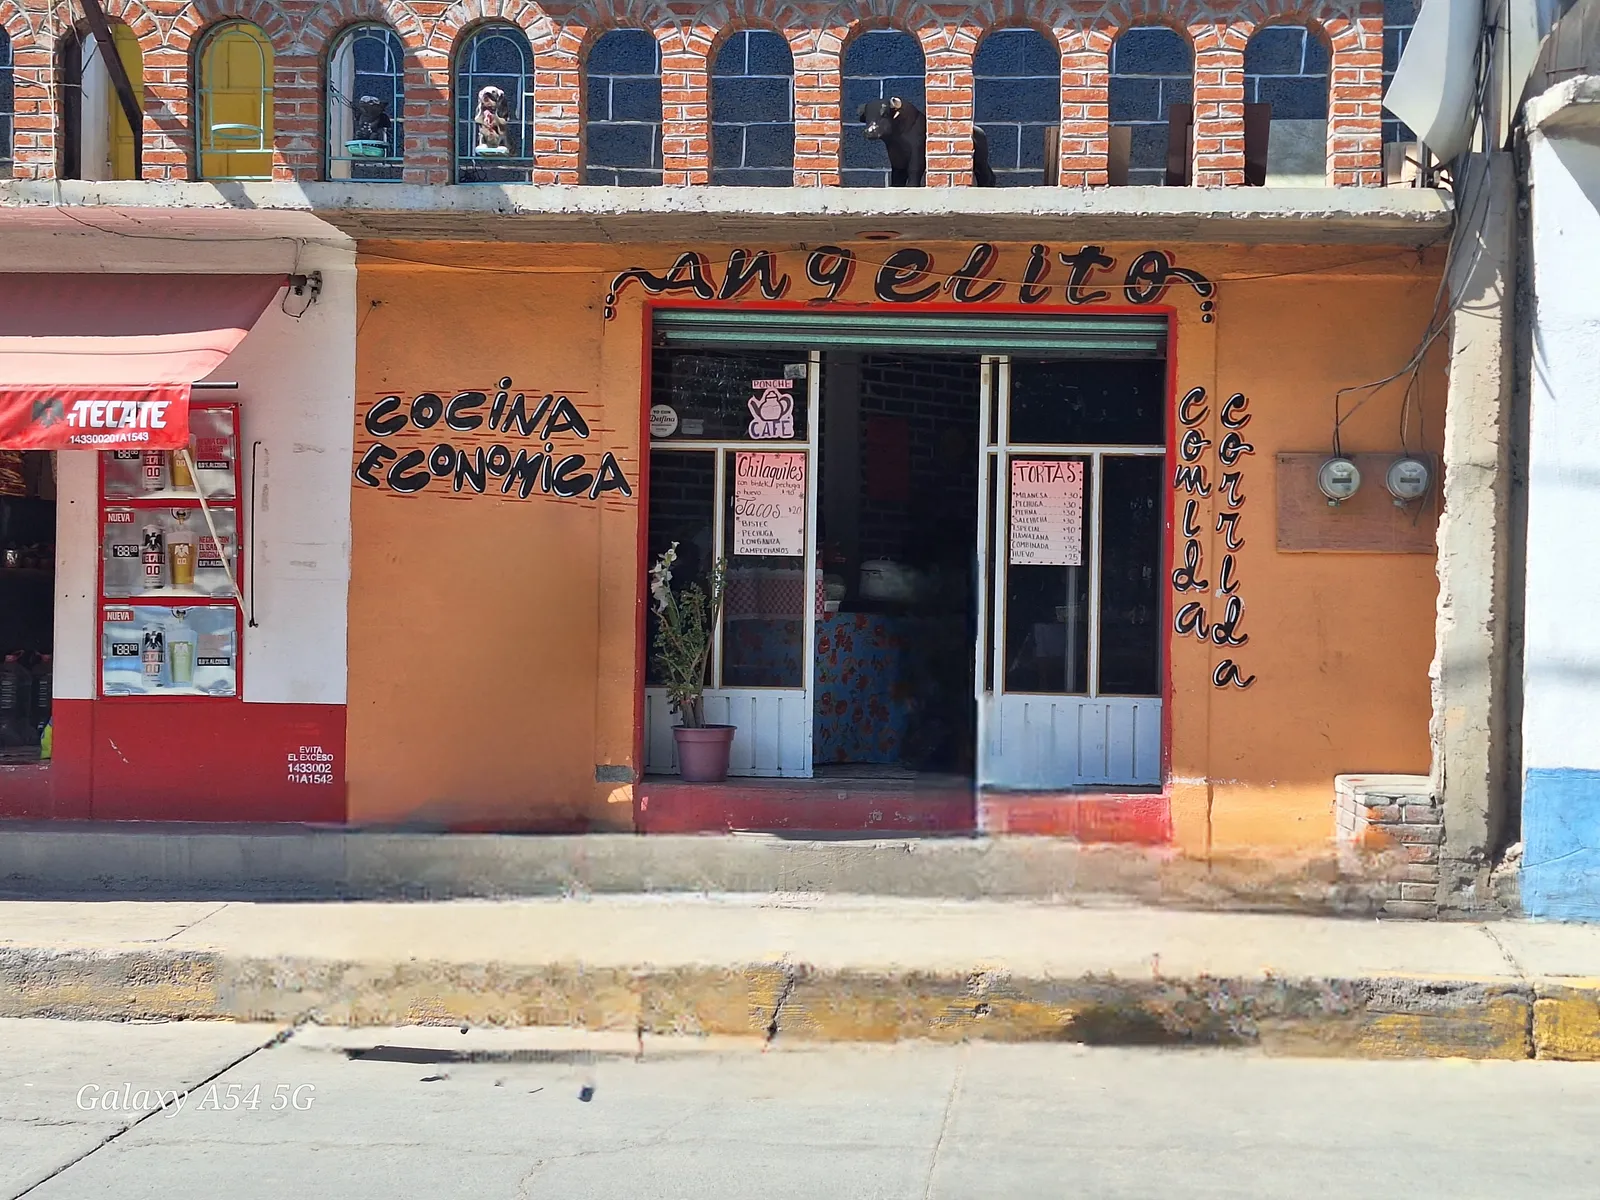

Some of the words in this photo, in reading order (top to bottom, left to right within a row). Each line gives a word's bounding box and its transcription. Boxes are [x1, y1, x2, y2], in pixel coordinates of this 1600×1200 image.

[753, 380, 791, 389] PONCHE
[66, 400, 172, 429] TECATE
[738, 455, 803, 488] Chilaquiles
[1015, 464, 1076, 483] TORTAS
[776, 481, 800, 490] pechuga
[108, 513, 130, 522] NUEVA
[1012, 540, 1050, 550] COMBINADA
[107, 612, 130, 620] NUEVA
[300, 746, 322, 754] EVITA
[288, 763, 332, 773] 1433002
